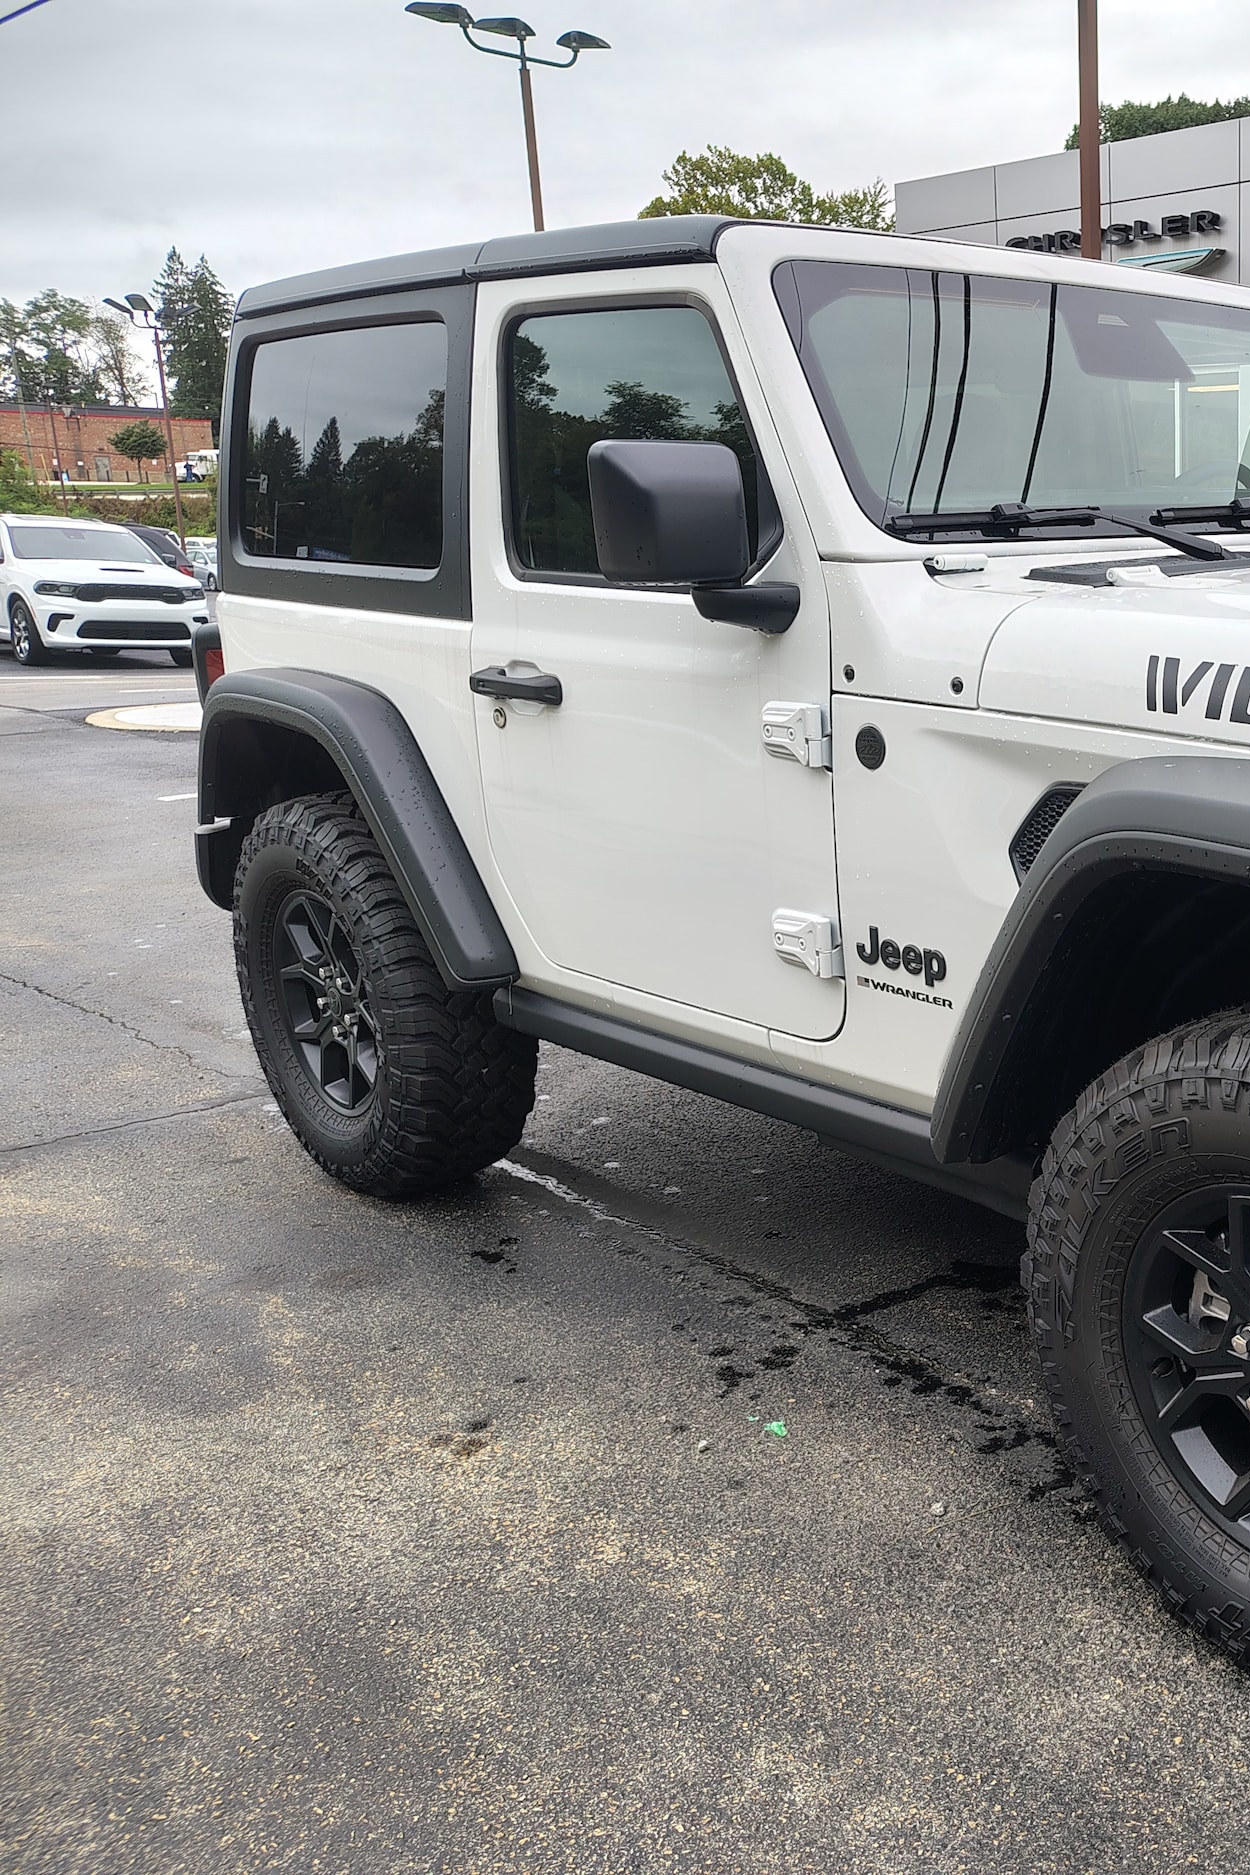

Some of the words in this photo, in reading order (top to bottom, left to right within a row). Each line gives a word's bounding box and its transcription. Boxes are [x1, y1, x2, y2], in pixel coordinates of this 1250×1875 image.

[1005, 211, 1220, 252] CHRSLER
[856, 925, 947, 988] Jeep
[870, 979, 954, 1010] WRANGLER
